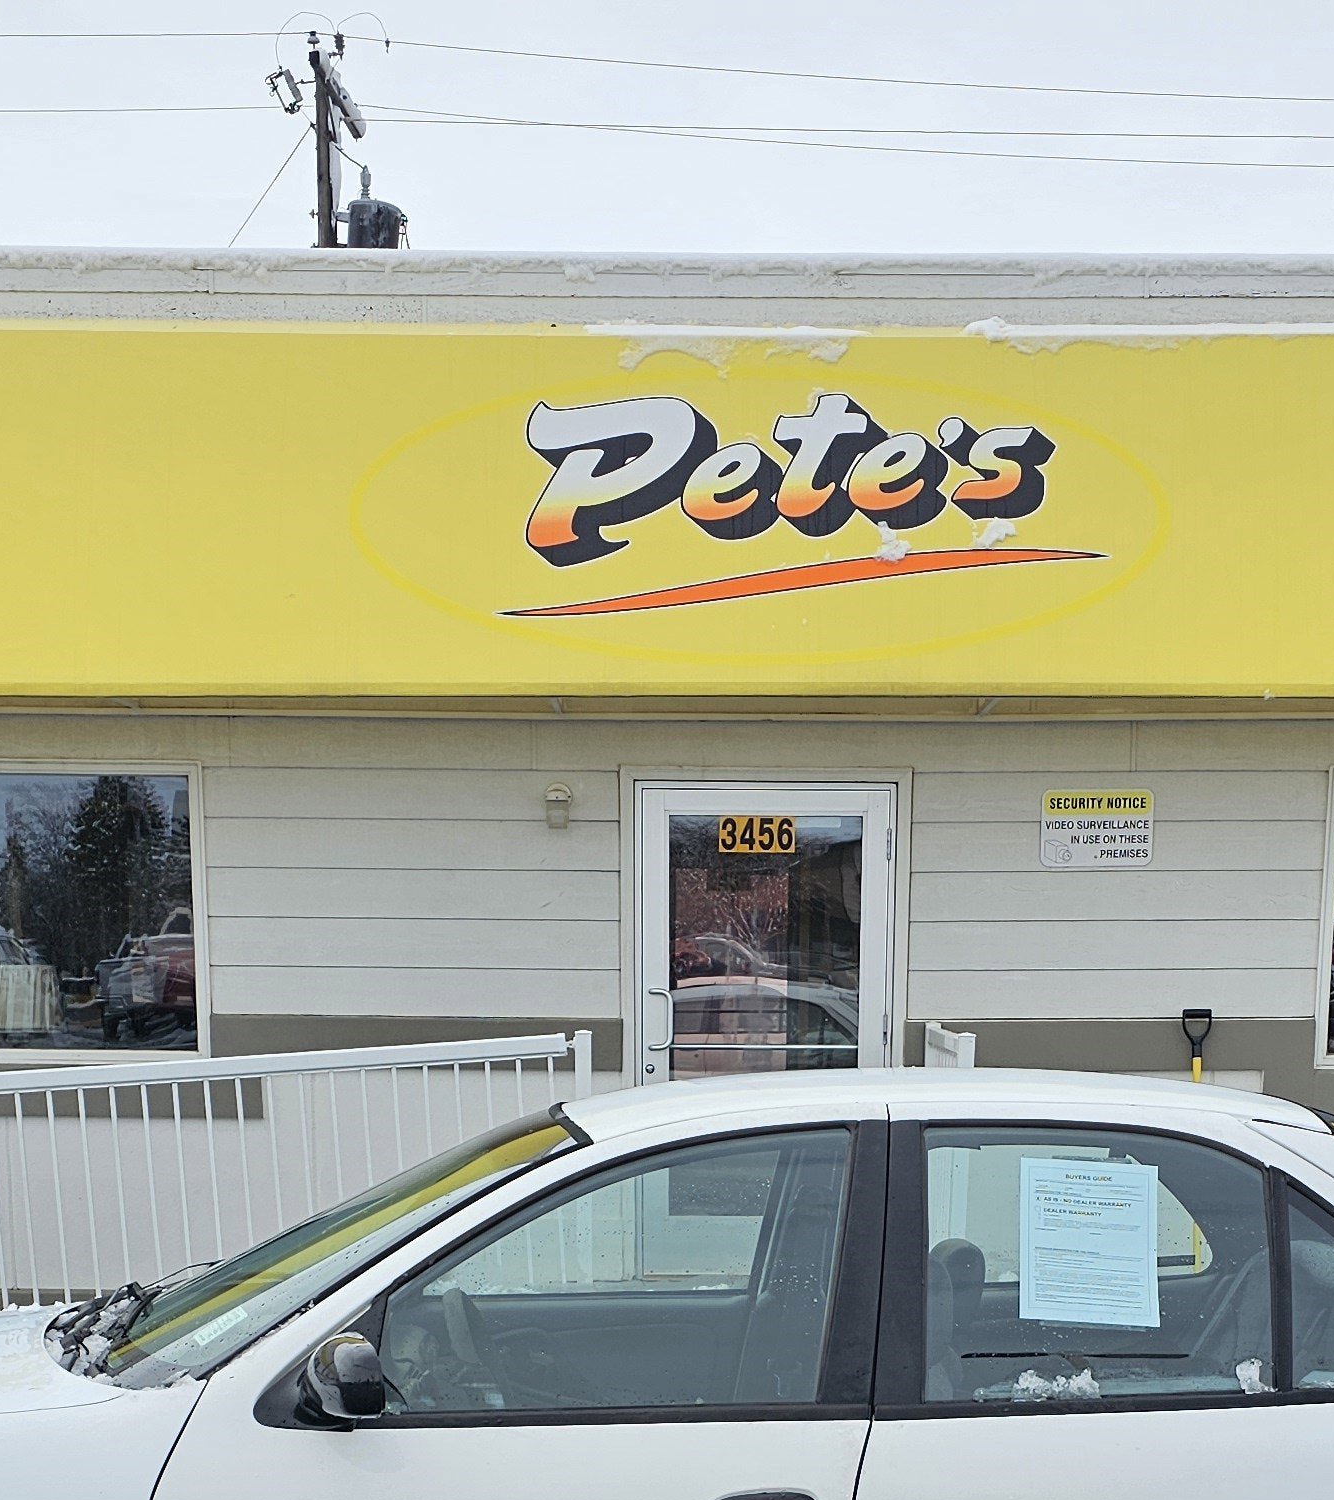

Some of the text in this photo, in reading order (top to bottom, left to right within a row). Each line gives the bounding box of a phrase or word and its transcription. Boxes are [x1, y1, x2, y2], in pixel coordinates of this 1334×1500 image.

[525, 392, 1056, 568] Pete's
[1049, 797, 1147, 810] SECURITY NOTICE
[1045, 820, 1150, 830] VIDEO SURVEILLANCE
[720, 817, 793, 851] 3456
[1070, 834, 1149, 844] IN USE ON THESE
[1099, 849, 1149, 859] PREMISES
[1065, 1173, 1091, 1181] BUYERS
[1098, 1200, 1132, 1208] WARRANTY
[1068, 1209, 1102, 1217] WARRANTY
